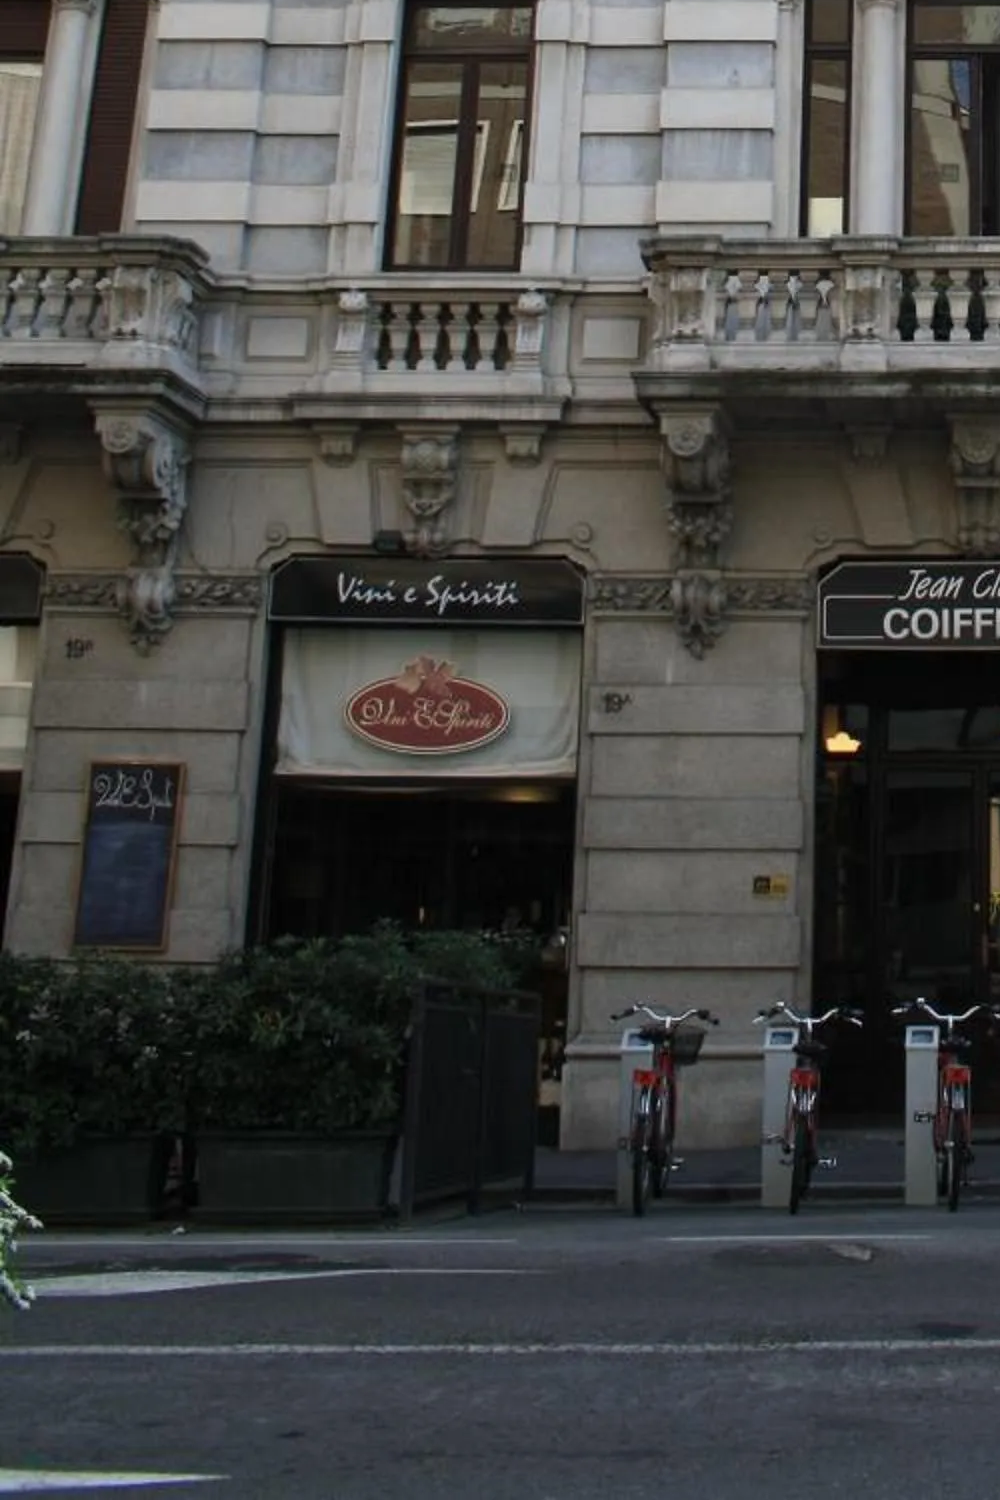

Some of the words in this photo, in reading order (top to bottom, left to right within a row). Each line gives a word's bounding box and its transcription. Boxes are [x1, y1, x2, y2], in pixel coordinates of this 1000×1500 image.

[337, 571, 397, 604] Vini
[403, 586, 418, 603] e
[425, 574, 520, 616] Spiriti
[898, 568, 965, 601] Jean
[360, 697, 408, 727] Vini
